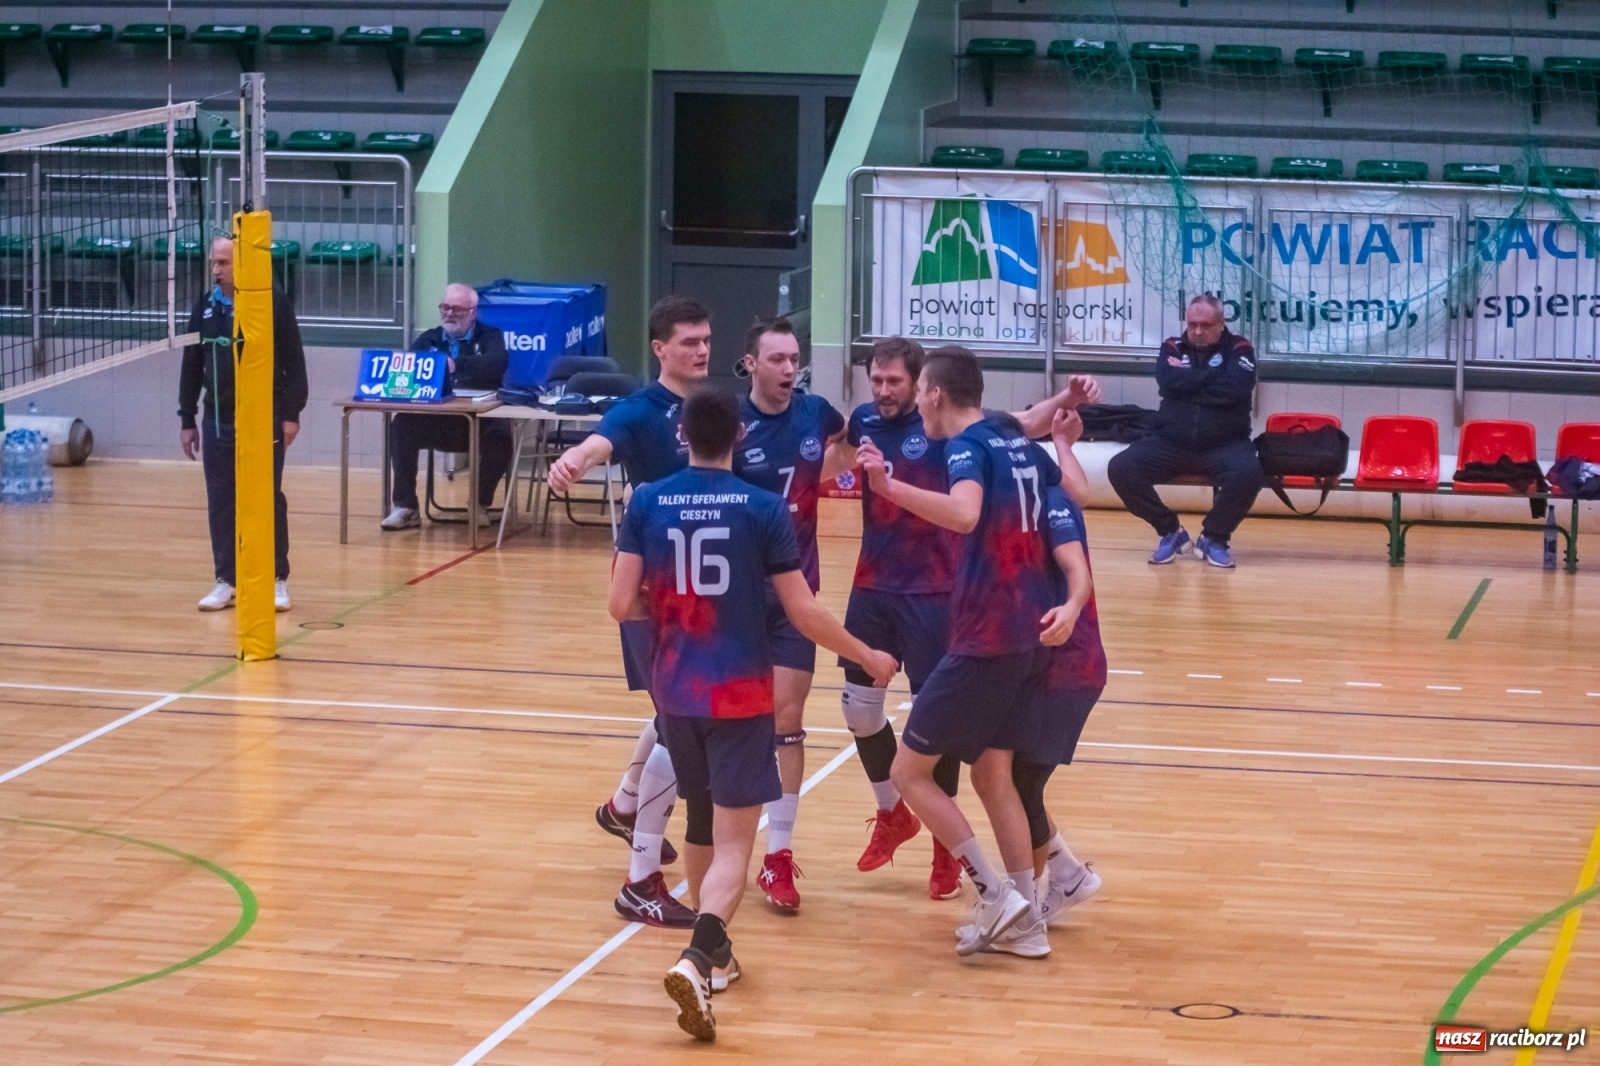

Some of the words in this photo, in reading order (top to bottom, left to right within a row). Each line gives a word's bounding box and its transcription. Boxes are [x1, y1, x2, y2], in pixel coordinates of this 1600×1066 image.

[1182, 221, 1435, 265] POWIAT
[909, 293, 996, 320] powiat
[1013, 297, 1133, 320] racborski
[1178, 290, 1418, 331] bicujemy,
[909, 322, 984, 338] zielona
[371, 356, 389, 378] 17
[416, 357, 435, 380] 19
[778, 466, 795, 498] 7
[658, 494, 690, 505] TALENT
[692, 494, 749, 505] SFERAWENT
[1011, 465, 1041, 533] 17
[680, 509, 721, 521] CIESZYN
[667, 527, 730, 596] 16
